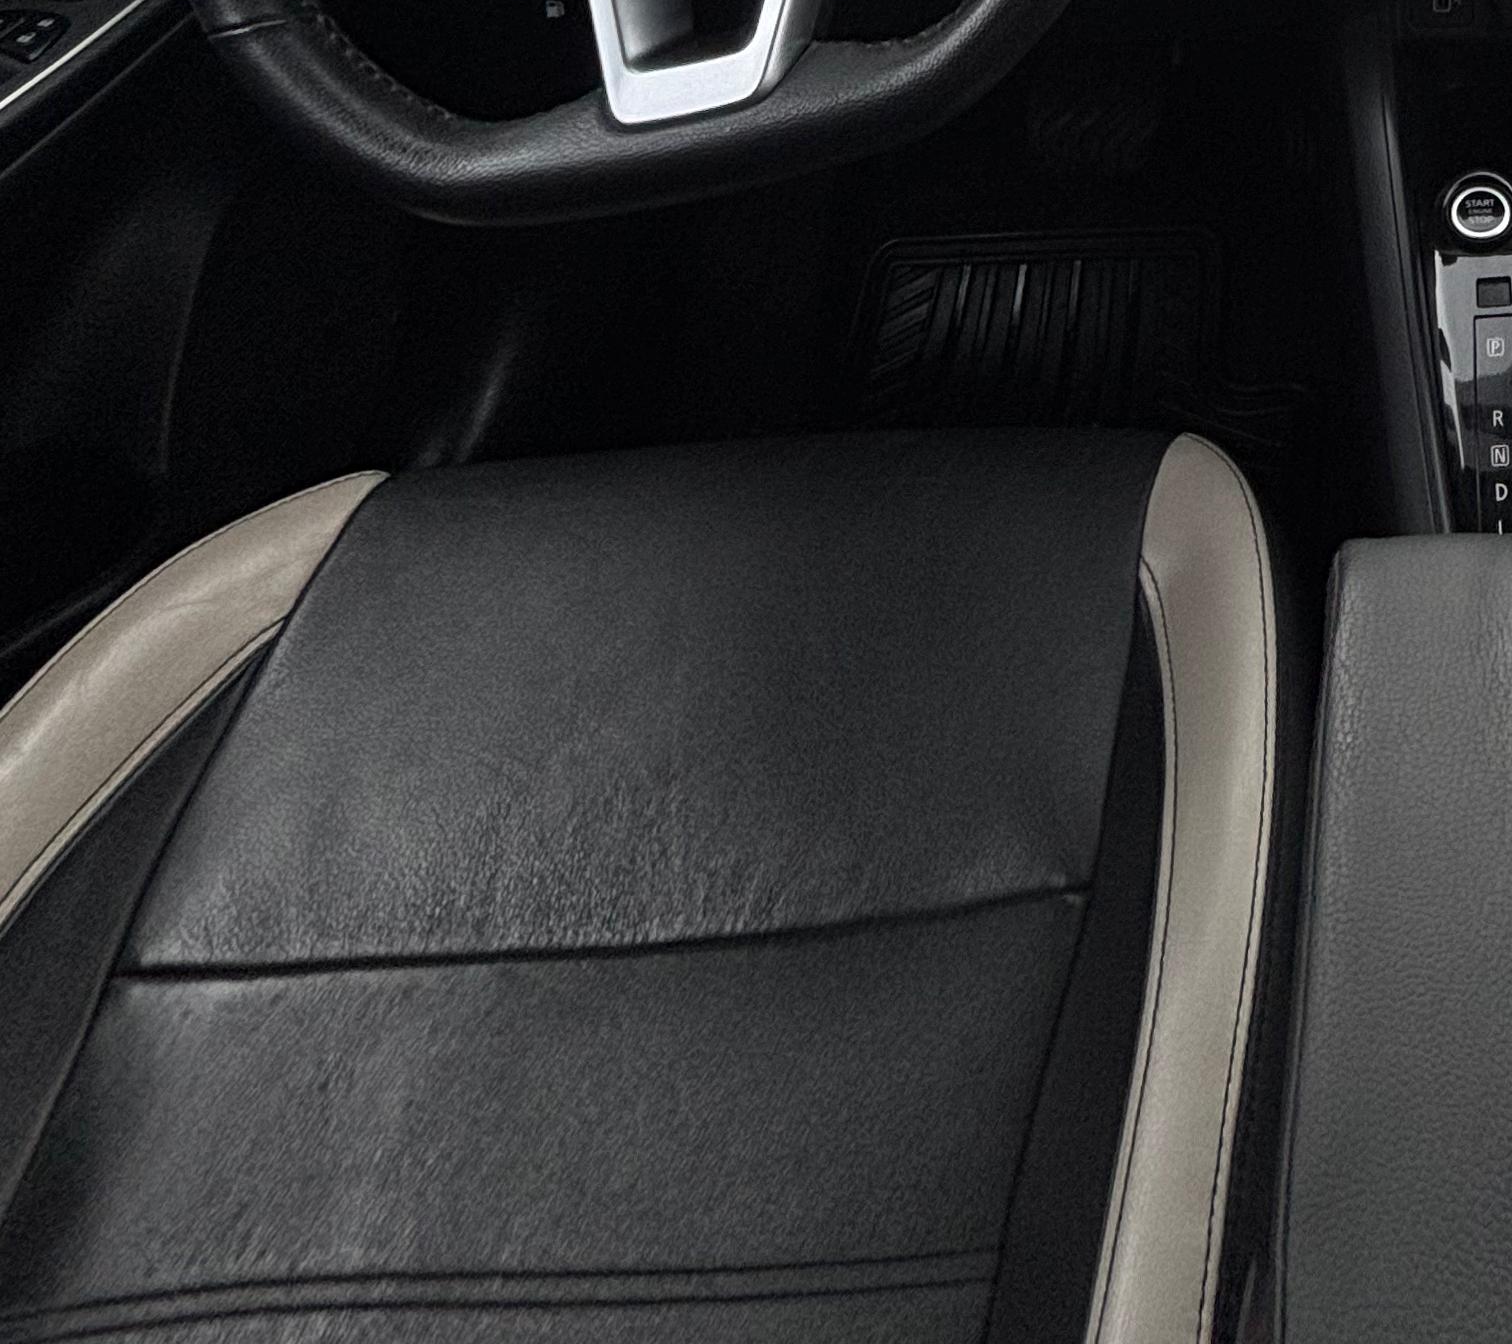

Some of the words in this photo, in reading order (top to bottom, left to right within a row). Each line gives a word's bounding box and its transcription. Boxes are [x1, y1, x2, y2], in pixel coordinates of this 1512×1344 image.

[1464, 198, 1495, 208] START
[1492, 410, 1504, 427] R
[1494, 448, 1505, 463] N
[1494, 483, 1508, 502] D
